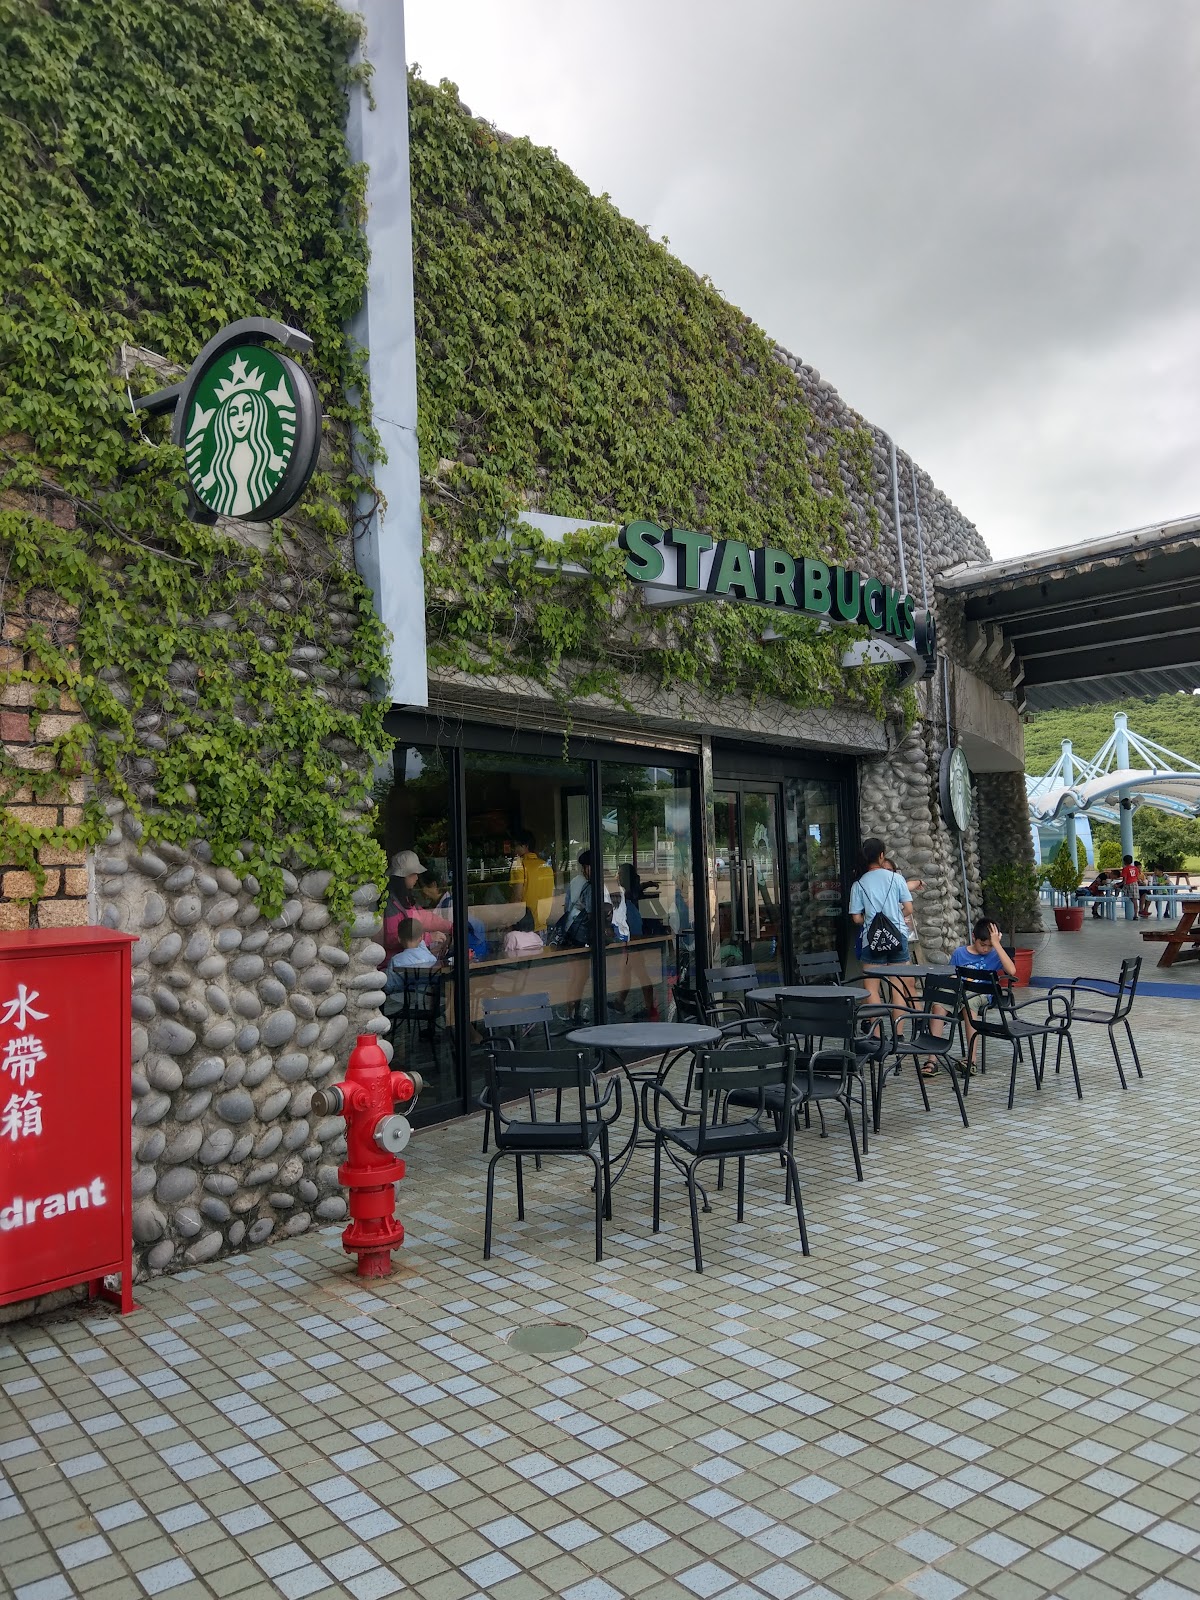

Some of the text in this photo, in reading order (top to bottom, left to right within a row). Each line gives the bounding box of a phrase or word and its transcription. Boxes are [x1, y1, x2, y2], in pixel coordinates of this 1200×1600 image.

[619, 521, 914, 641] STARBUCKS
[870, 928, 900, 952] NEVER SAY NEVER
[0, 984, 50, 1142] 水帶箱
[0, 1176, 107, 1232] drant
